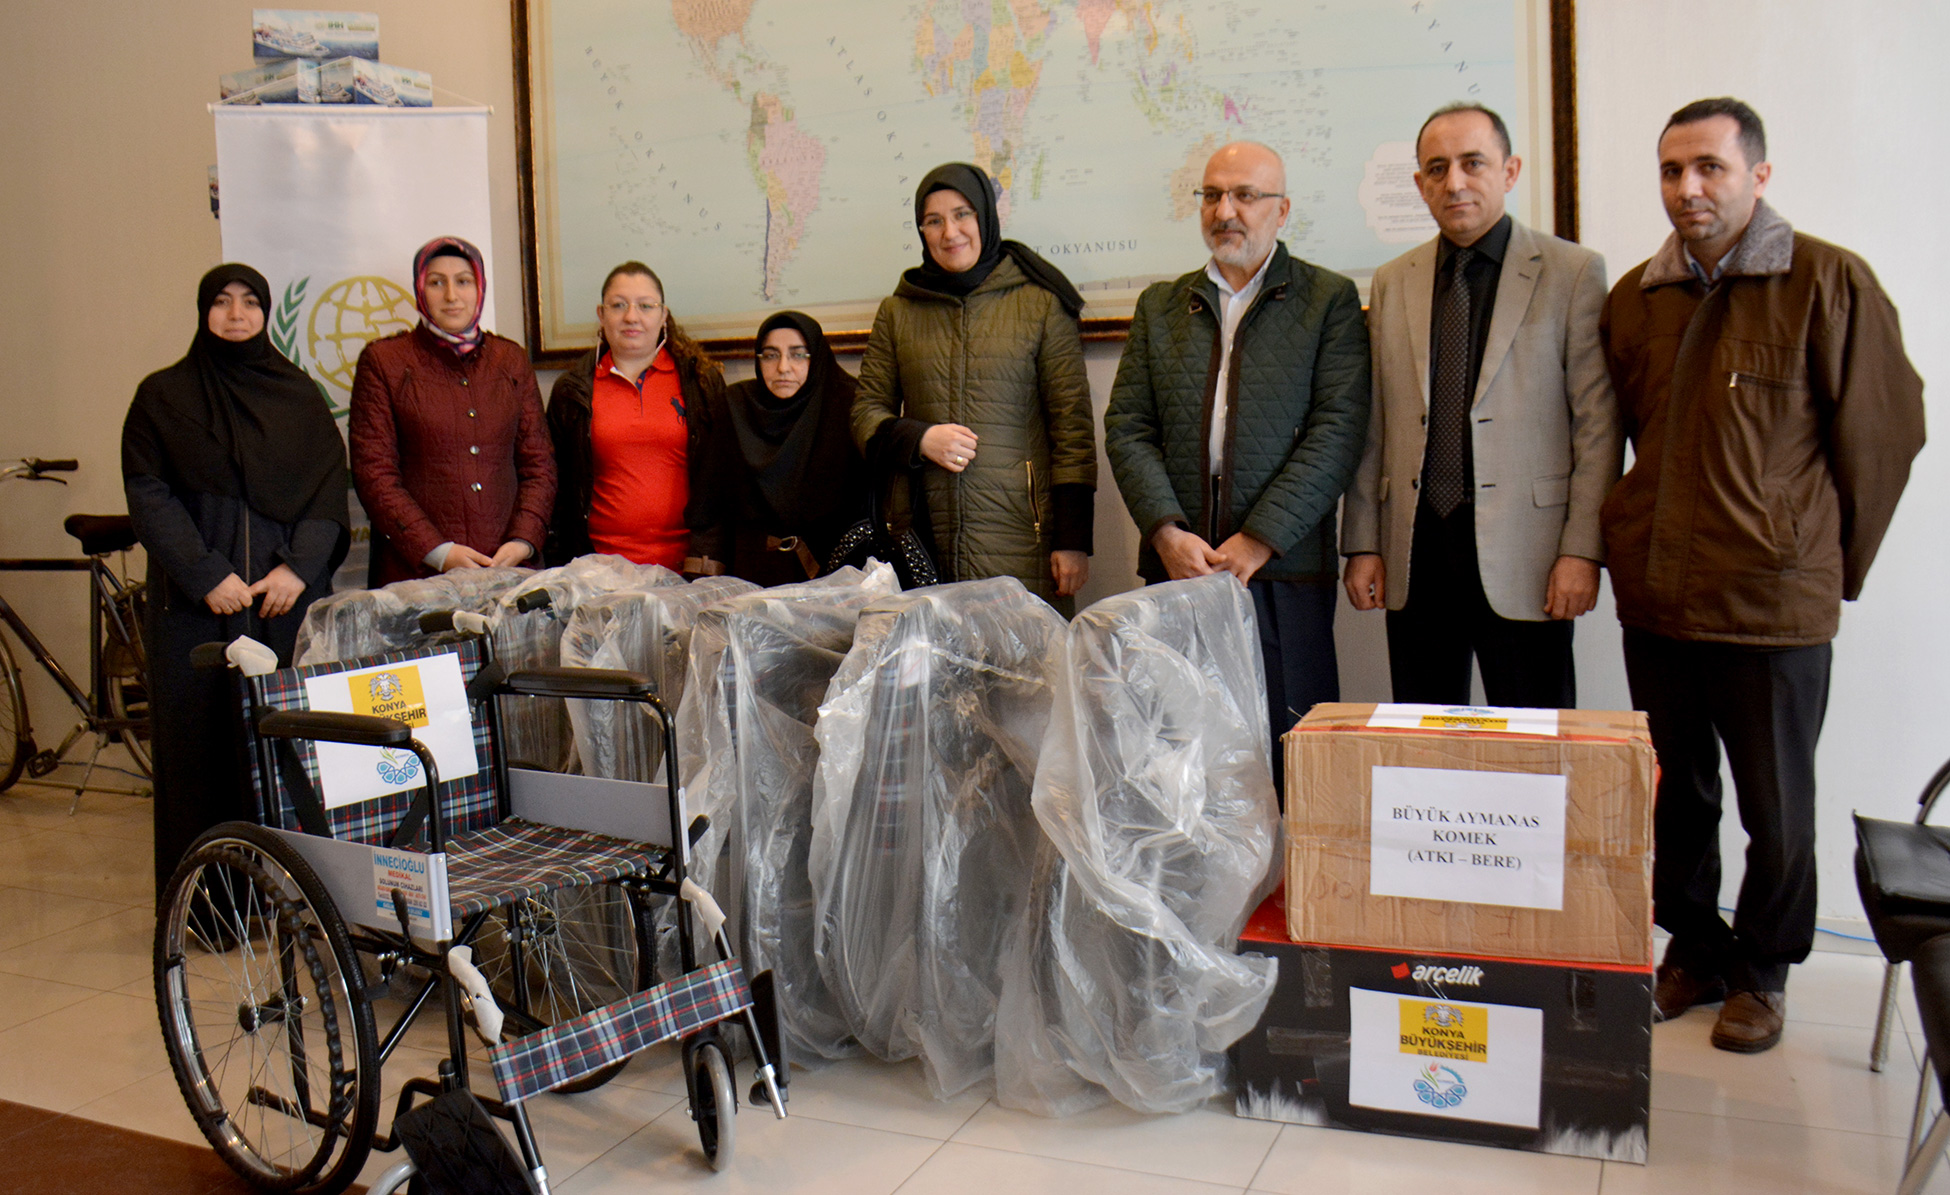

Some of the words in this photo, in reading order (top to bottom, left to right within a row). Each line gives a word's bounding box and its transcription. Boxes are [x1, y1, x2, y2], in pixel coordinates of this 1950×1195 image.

[1050, 240, 1138, 255] OKYANUSU
[372, 700, 407, 714] KONYA
[1392, 805, 1450, 823] BÜYÜK
[1455, 812, 1540, 828] AYMANAS
[1433, 829, 1497, 846] KOMEK
[1408, 850, 1454, 864] (ATKI
[1472, 853, 1522, 871] BERE)
[1412, 964, 1485, 986] arçelik
[1422, 1026, 1466, 1039] KONYA
[1400, 1033, 1487, 1055] BÜYÜKŞEHİR
